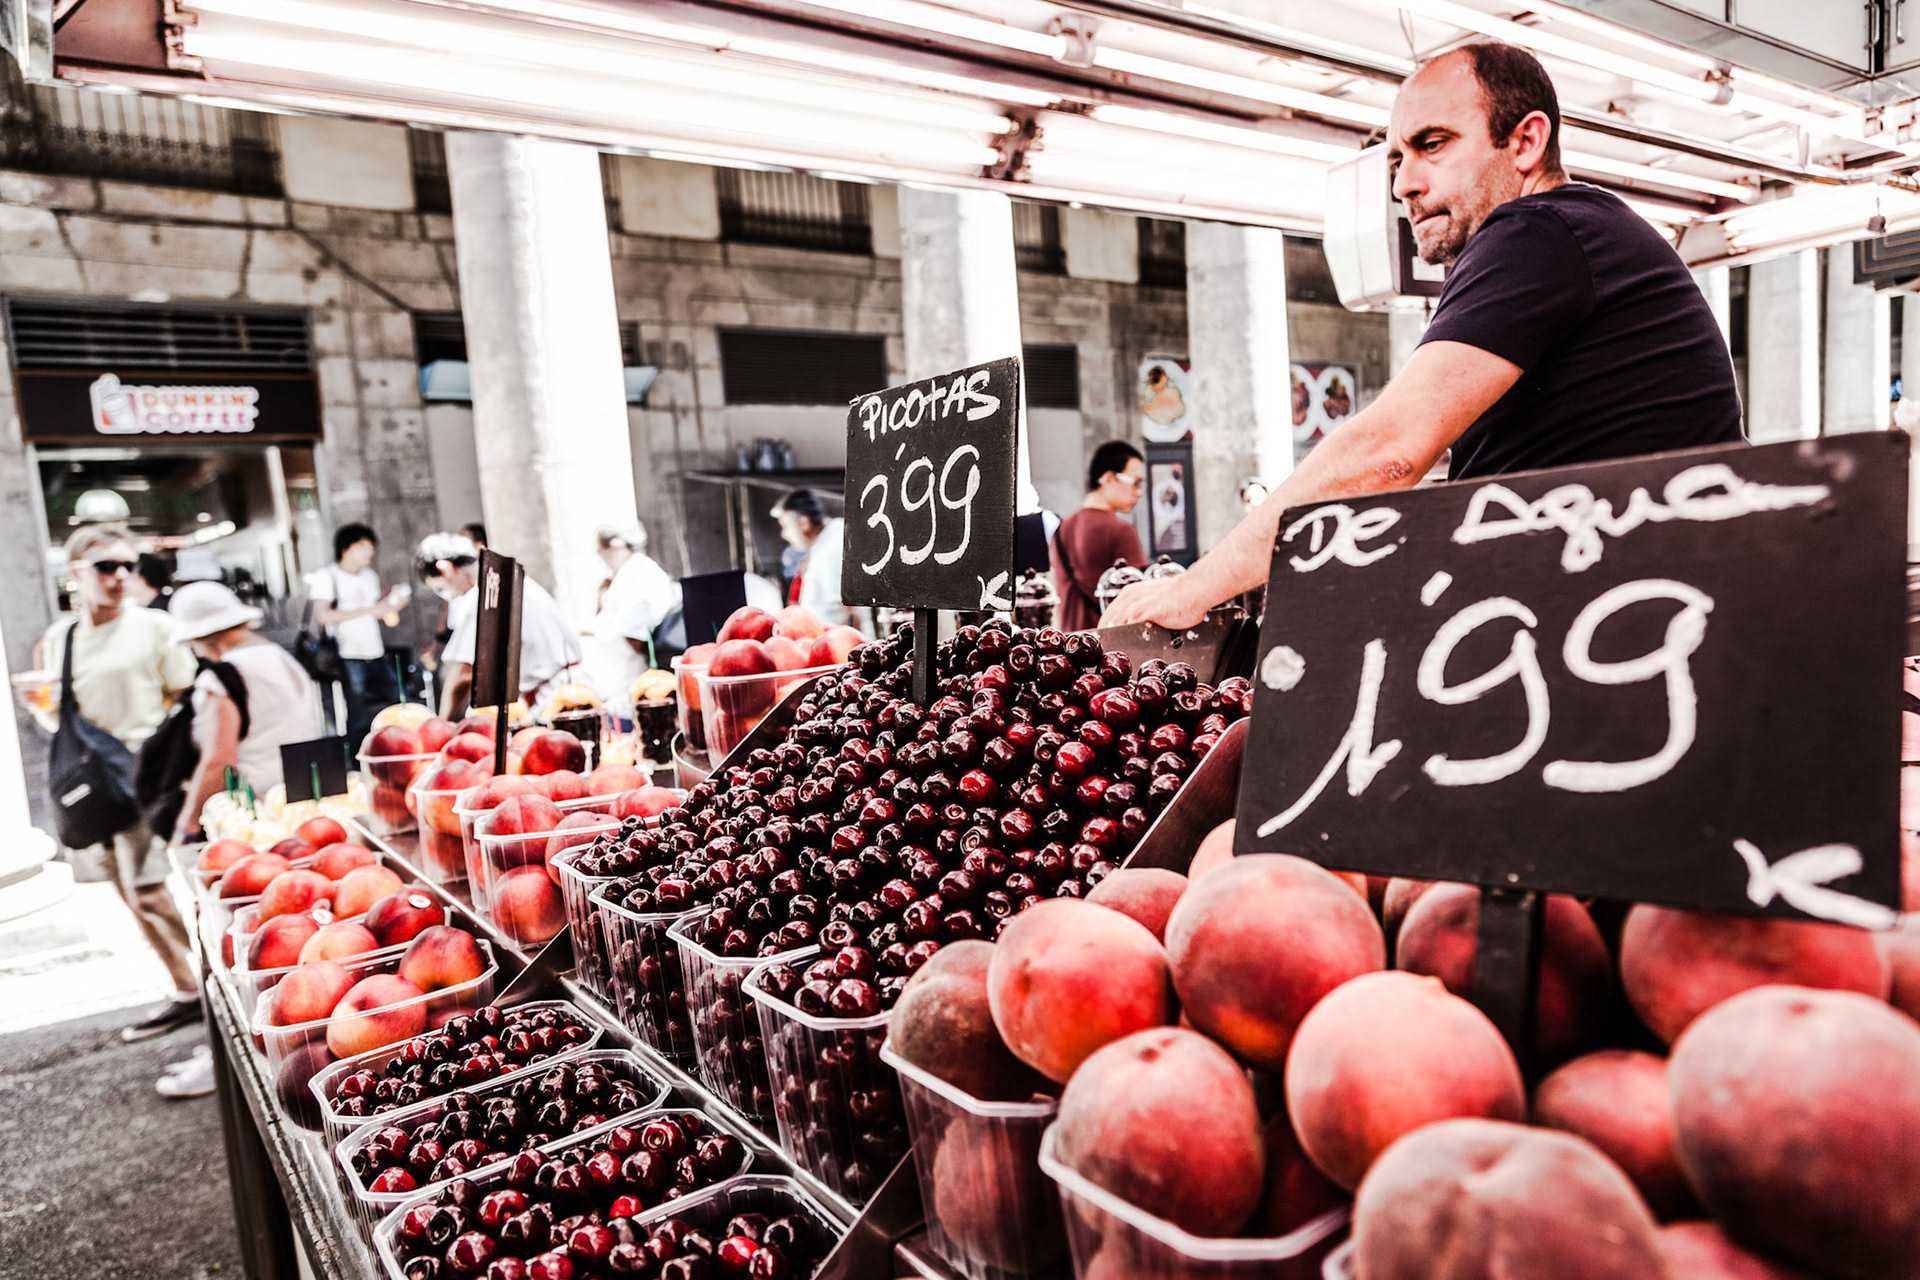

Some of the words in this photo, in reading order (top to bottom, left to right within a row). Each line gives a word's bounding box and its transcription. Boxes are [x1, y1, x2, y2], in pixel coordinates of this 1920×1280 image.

[145, 411, 247, 426] COFFEE
[1451, 463, 1831, 573] Agua
[976, 570, 1013, 611] K
[1733, 838, 1901, 931] K
